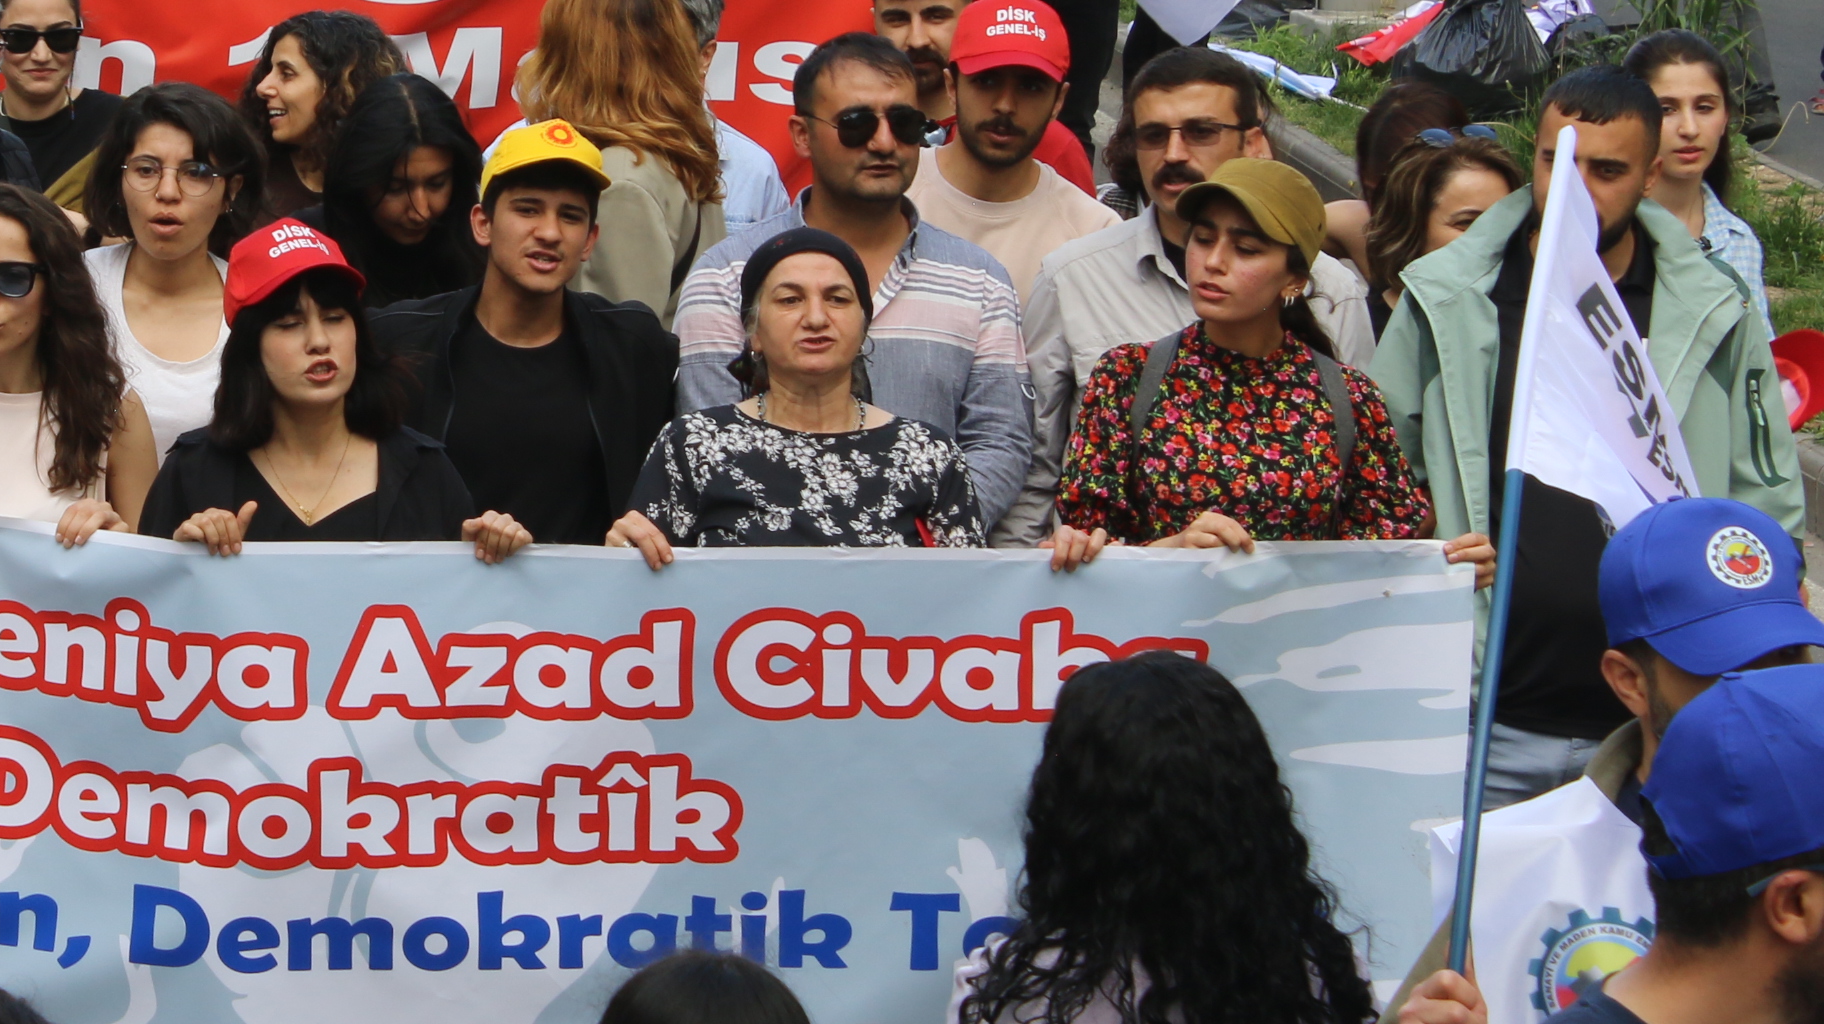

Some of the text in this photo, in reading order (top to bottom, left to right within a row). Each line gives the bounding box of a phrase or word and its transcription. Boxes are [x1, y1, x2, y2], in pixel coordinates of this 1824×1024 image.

[996, 5, 1036, 24] DİSK
[986, 23, 1046, 42] GENEL-İŞ
[271, 224, 316, 243] DİSK
[327, 605, 694, 719] Azad
[129, 884, 853, 974] Demokratik
[1559, 926, 1597, 951] MADEN
[1599, 925, 1633, 939] KAMU
